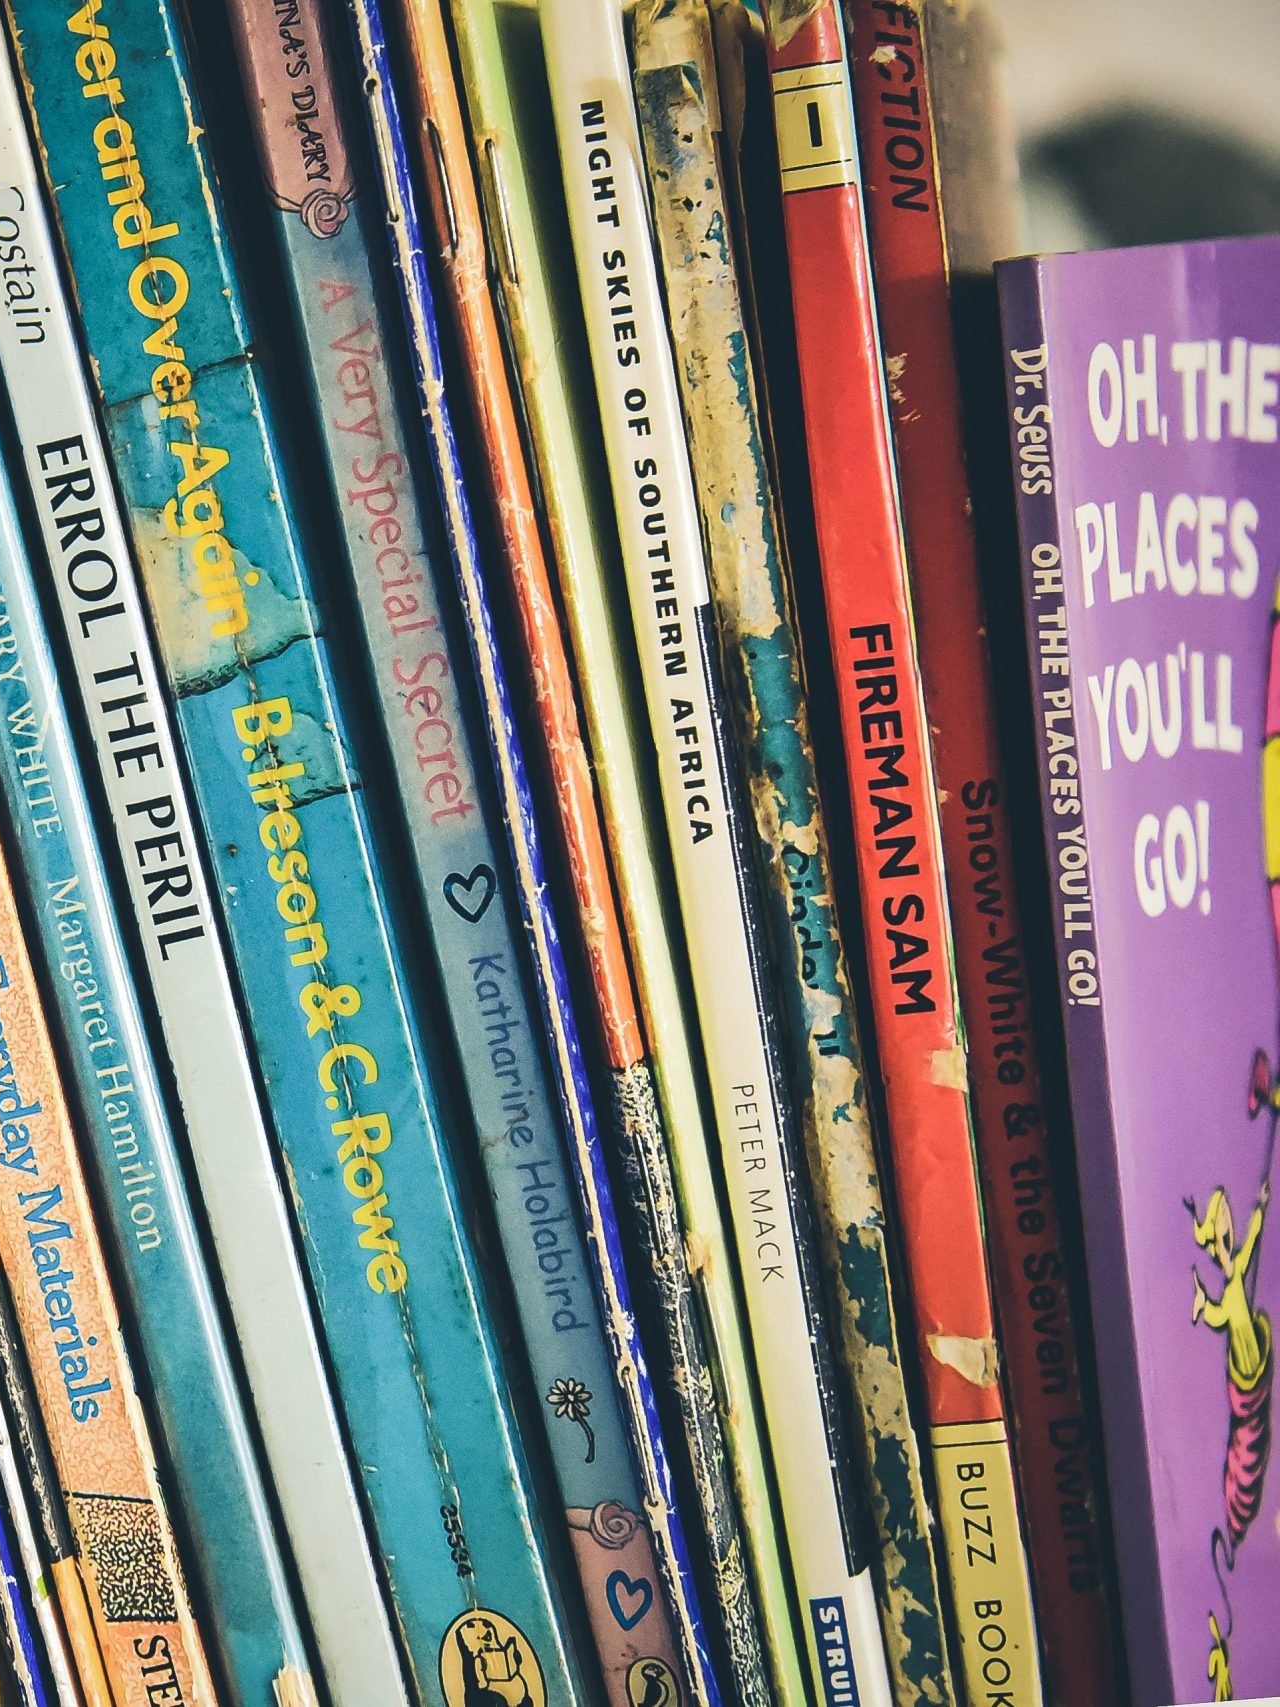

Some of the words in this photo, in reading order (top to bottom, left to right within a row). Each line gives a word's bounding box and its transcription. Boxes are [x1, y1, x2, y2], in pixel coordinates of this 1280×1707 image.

[291, 84, 331, 182] DIARY
[580, 99, 620, 227] NIGHT
[868, 0, 931, 213] FICTION
[93, 113, 179, 248] and
[128, 255, 200, 429] Over
[318, 281, 355, 310] A
[602, 249, 640, 367] SKIES
[330, 318, 384, 439] Very
[623, 388, 651, 436] OF
[1010, 344, 1050, 394] Dr.
[1088, 333, 1168, 448] OH,
[1171, 336, 1279, 444] THE
[1014, 404, 1056, 496] Seuss
[36, 434, 125, 638] ERROL
[163, 441, 260, 638] Again
[347, 451, 436, 635] Special
[634, 458, 687, 676] SOUTHERN
[1031, 540, 1068, 599] OH,
[1075, 492, 1259, 608] PLACES
[1037, 605, 1073, 676] THE
[92, 651, 164, 778] THE
[392, 651, 472, 823] Secret
[849, 623, 919, 879] FIREMAN
[1042, 685, 1085, 816] PLACES
[1087, 641, 1243, 770] YOU'LL
[4, 701, 64, 839] WHITE
[670, 698, 713, 844] AFRICA
[125, 794, 204, 961] PERIL
[1057, 822, 1093, 938] YOU'LL
[1134, 800, 1211, 917] GO!
[882, 893, 936, 1015] SAM
[959, 778, 1031, 1087] Snow-White
[1067, 949, 1100, 1005] GO!
[44, 875, 118, 1054] Margaret
[96, 1062, 166, 1254] Hamilton
[300, 981, 361, 1036] &
[468, 952, 534, 1148] Katharine
[516, 1158, 593, 1332] Holabird
[731, 1084, 765, 1172] PETER
[748, 1189, 784, 1282] MACK
[1002, 1102, 1040, 1140] &
[1009, 1154, 1053, 1237] the
[17, 1185, 111, 1423] Materials
[1023, 1251, 1074, 1395] Seven
[956, 1462, 996, 1566] BUZZ
[132, 1634, 184, 1707] STE
[817, 1605, 855, 1707] STRUI
[973, 1599, 1014, 1707] BOOK
